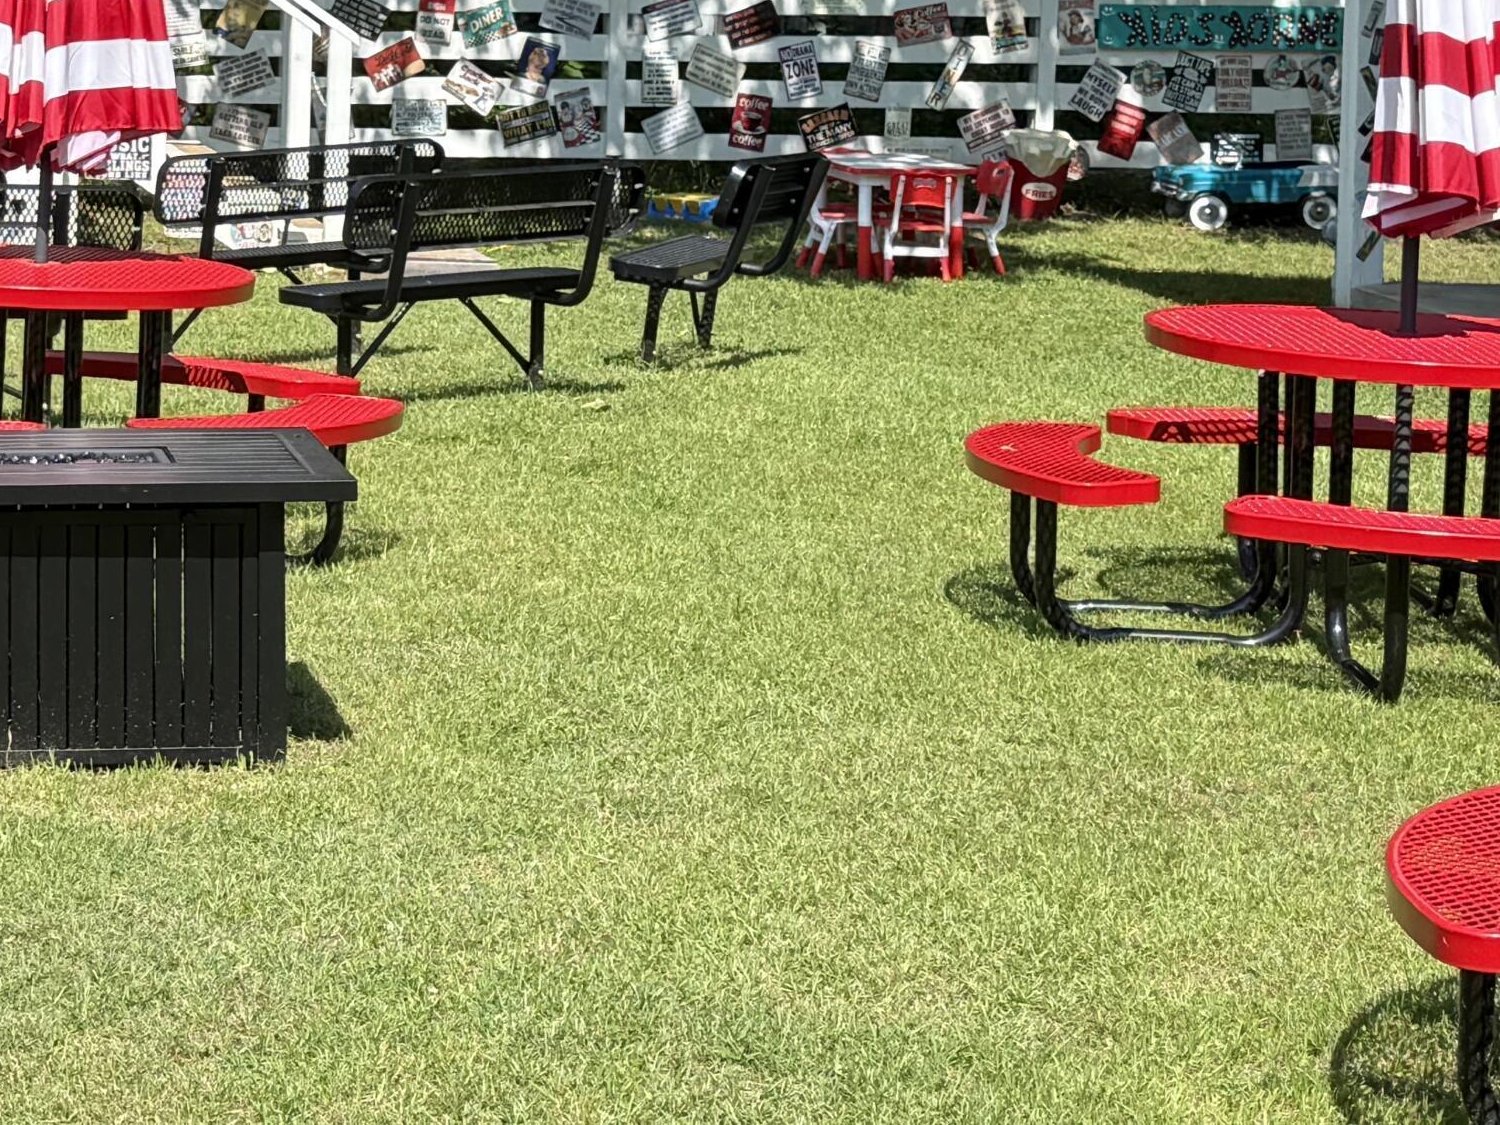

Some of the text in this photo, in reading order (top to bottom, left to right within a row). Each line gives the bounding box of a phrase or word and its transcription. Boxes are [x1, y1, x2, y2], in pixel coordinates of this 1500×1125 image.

[434, 17, 451, 25] NOT
[470, 5, 502, 33] DINER
[1220, 11, 1338, 47] KORNE
[786, 59, 815, 79] ZONE
[1087, 72, 1117, 95] MYSELF
[739, 98, 769, 110] coffee
[1071, 95, 1102, 119] LAUGH
[505, 126, 532, 139] WHAT
[732, 134, 762, 147] coffee
[1025, 189, 1055, 199] FRIES
